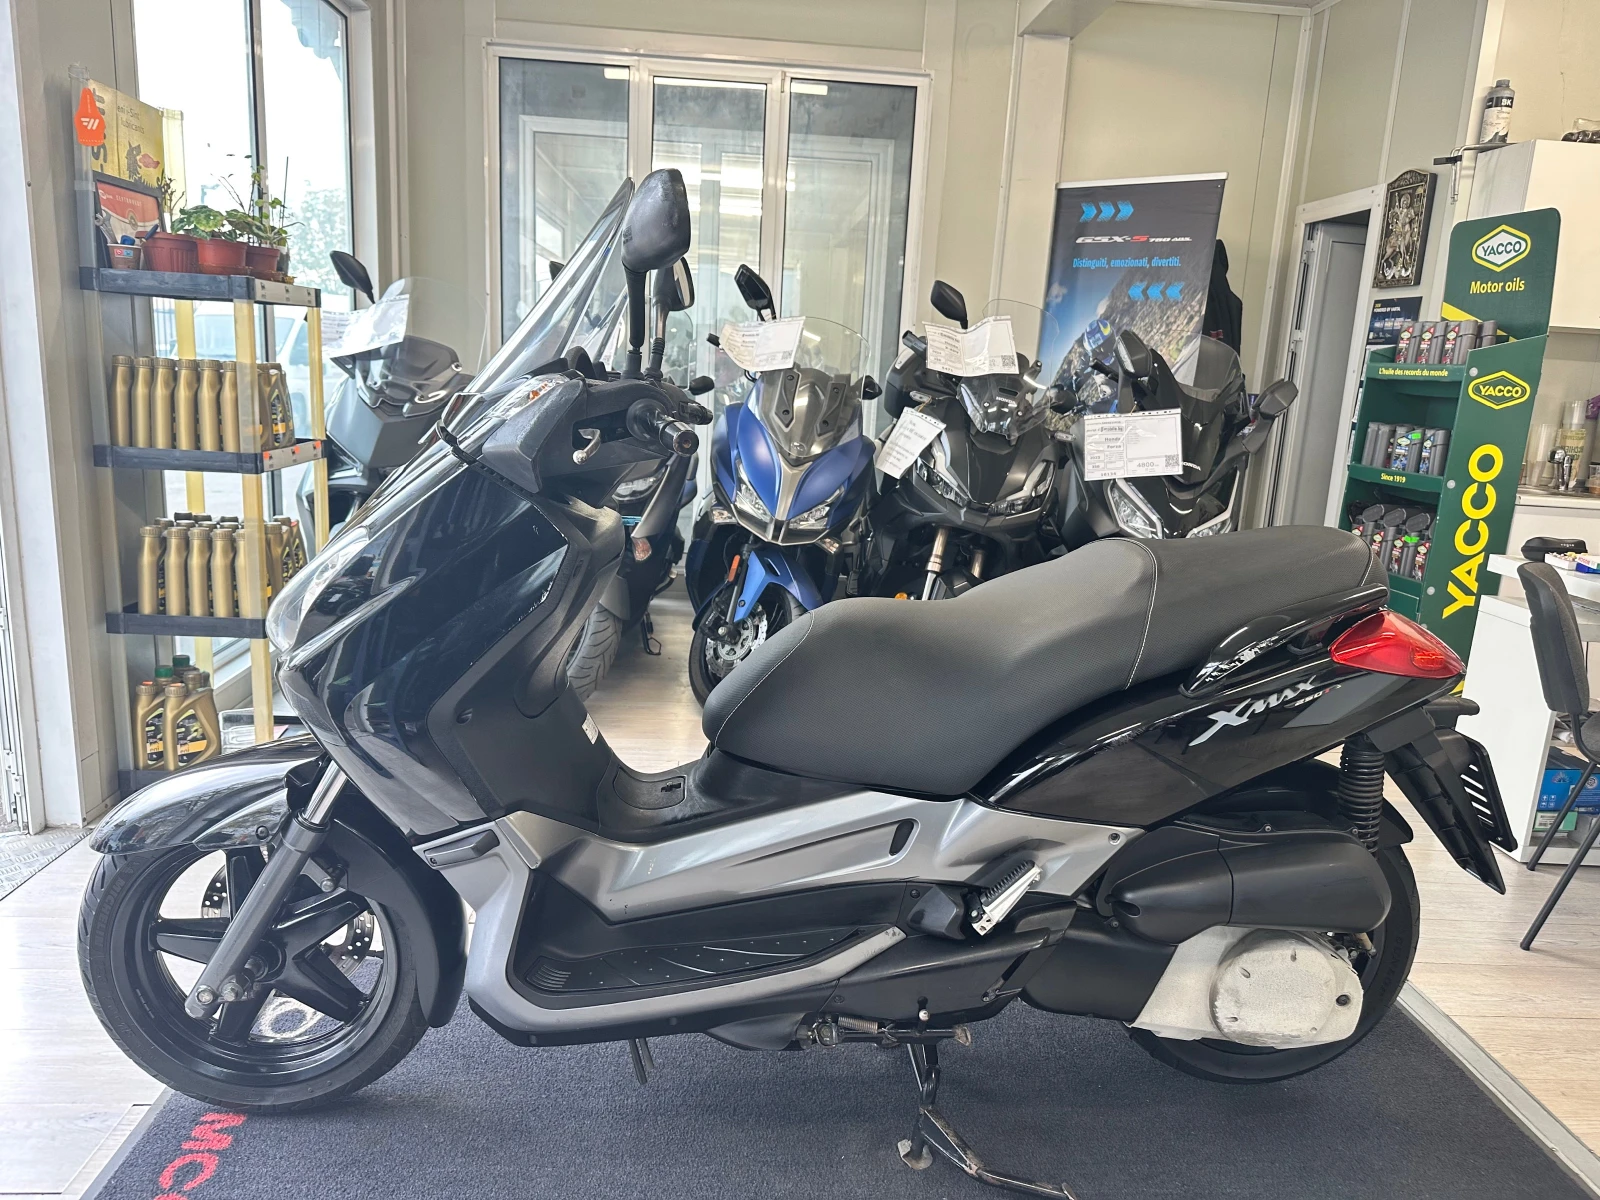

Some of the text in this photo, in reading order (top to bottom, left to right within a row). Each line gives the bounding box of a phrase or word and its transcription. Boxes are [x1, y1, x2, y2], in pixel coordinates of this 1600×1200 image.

[1501, 98, 1512, 106] BK
[1076, 235, 1149, 243] GSX-S
[1482, 241, 1522, 256] YACCO
[1073, 256, 1181, 269] Distinguiti, emozionati, divertiti.
[1470, 277, 1525, 294] Motor oils
[1379, 367, 1394, 375] L'huile
[1403, 368, 1421, 376] records
[1430, 369, 1448, 377] monde
[1479, 385, 1522, 397] YACCO
[996, 396, 1016, 405] HONDA
[1183, 461, 1201, 471] ONDA
[1381, 473, 1406, 483] Since 1919
[1442, 443, 1504, 619] YACCO
[94, 878, 127, 950] MICHELIN
